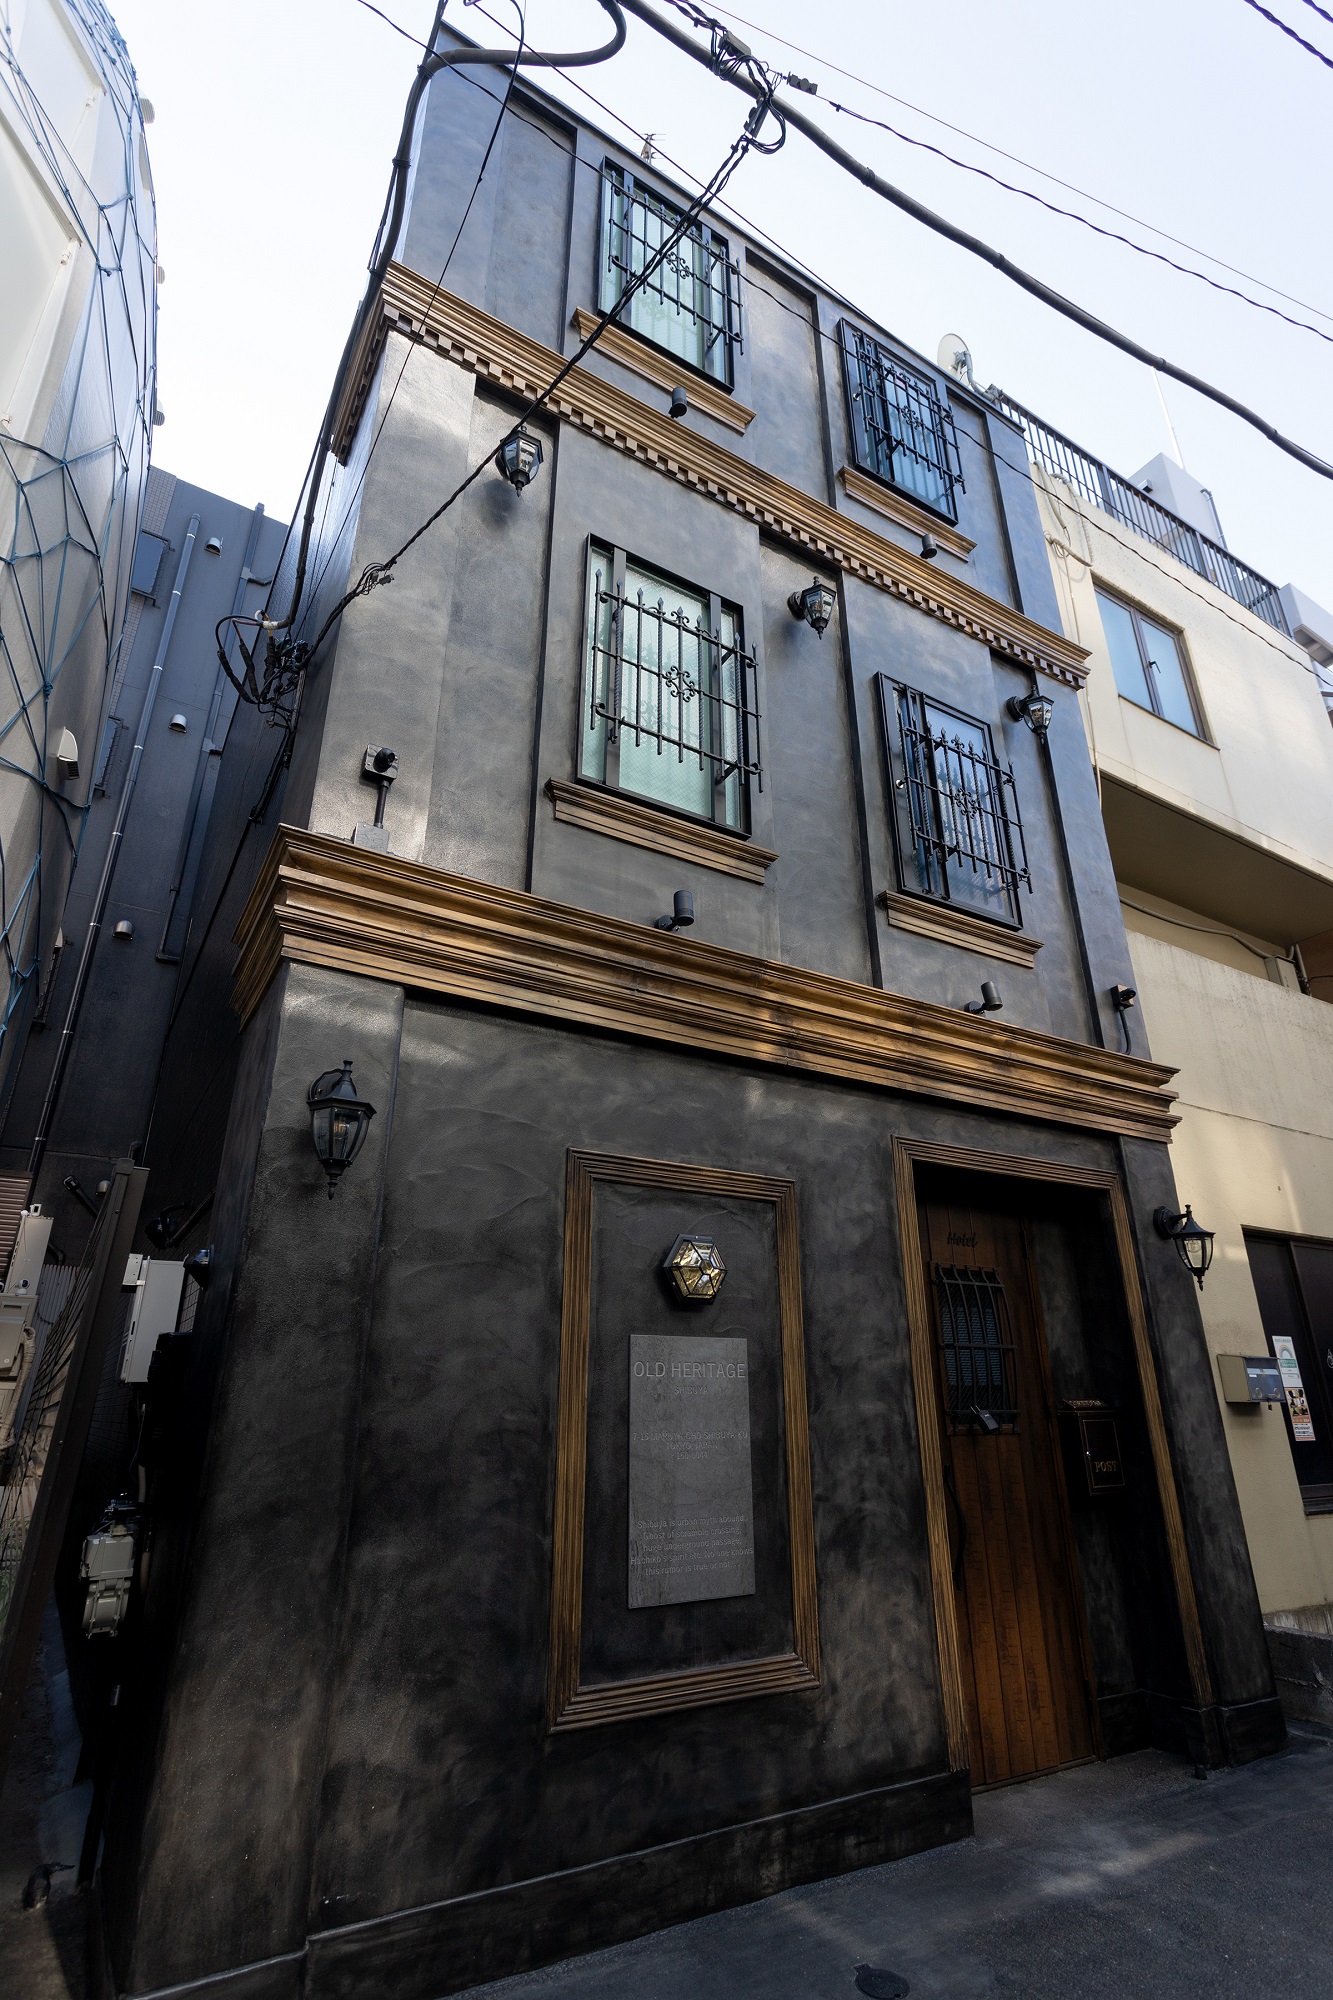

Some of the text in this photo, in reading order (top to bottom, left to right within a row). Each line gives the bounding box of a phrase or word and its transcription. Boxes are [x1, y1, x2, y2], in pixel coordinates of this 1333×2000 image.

[633, 1361, 746, 1378] OLD HERITAGE
[677, 1451, 708, 1460] 1500044
[1094, 1461, 1118, 1472] POST
[637, 1520, 667, 1529] Shibuya
[669, 1519, 675, 1527] is
[643, 1531, 665, 1540] Ghost
[668, 1530, 675, 1539] of
[663, 1541, 710, 1551] underground
[630, 1555, 667, 1565] Hachikos
[645, 1567, 660, 1576] this
[685, 1564, 692, 1572] is
